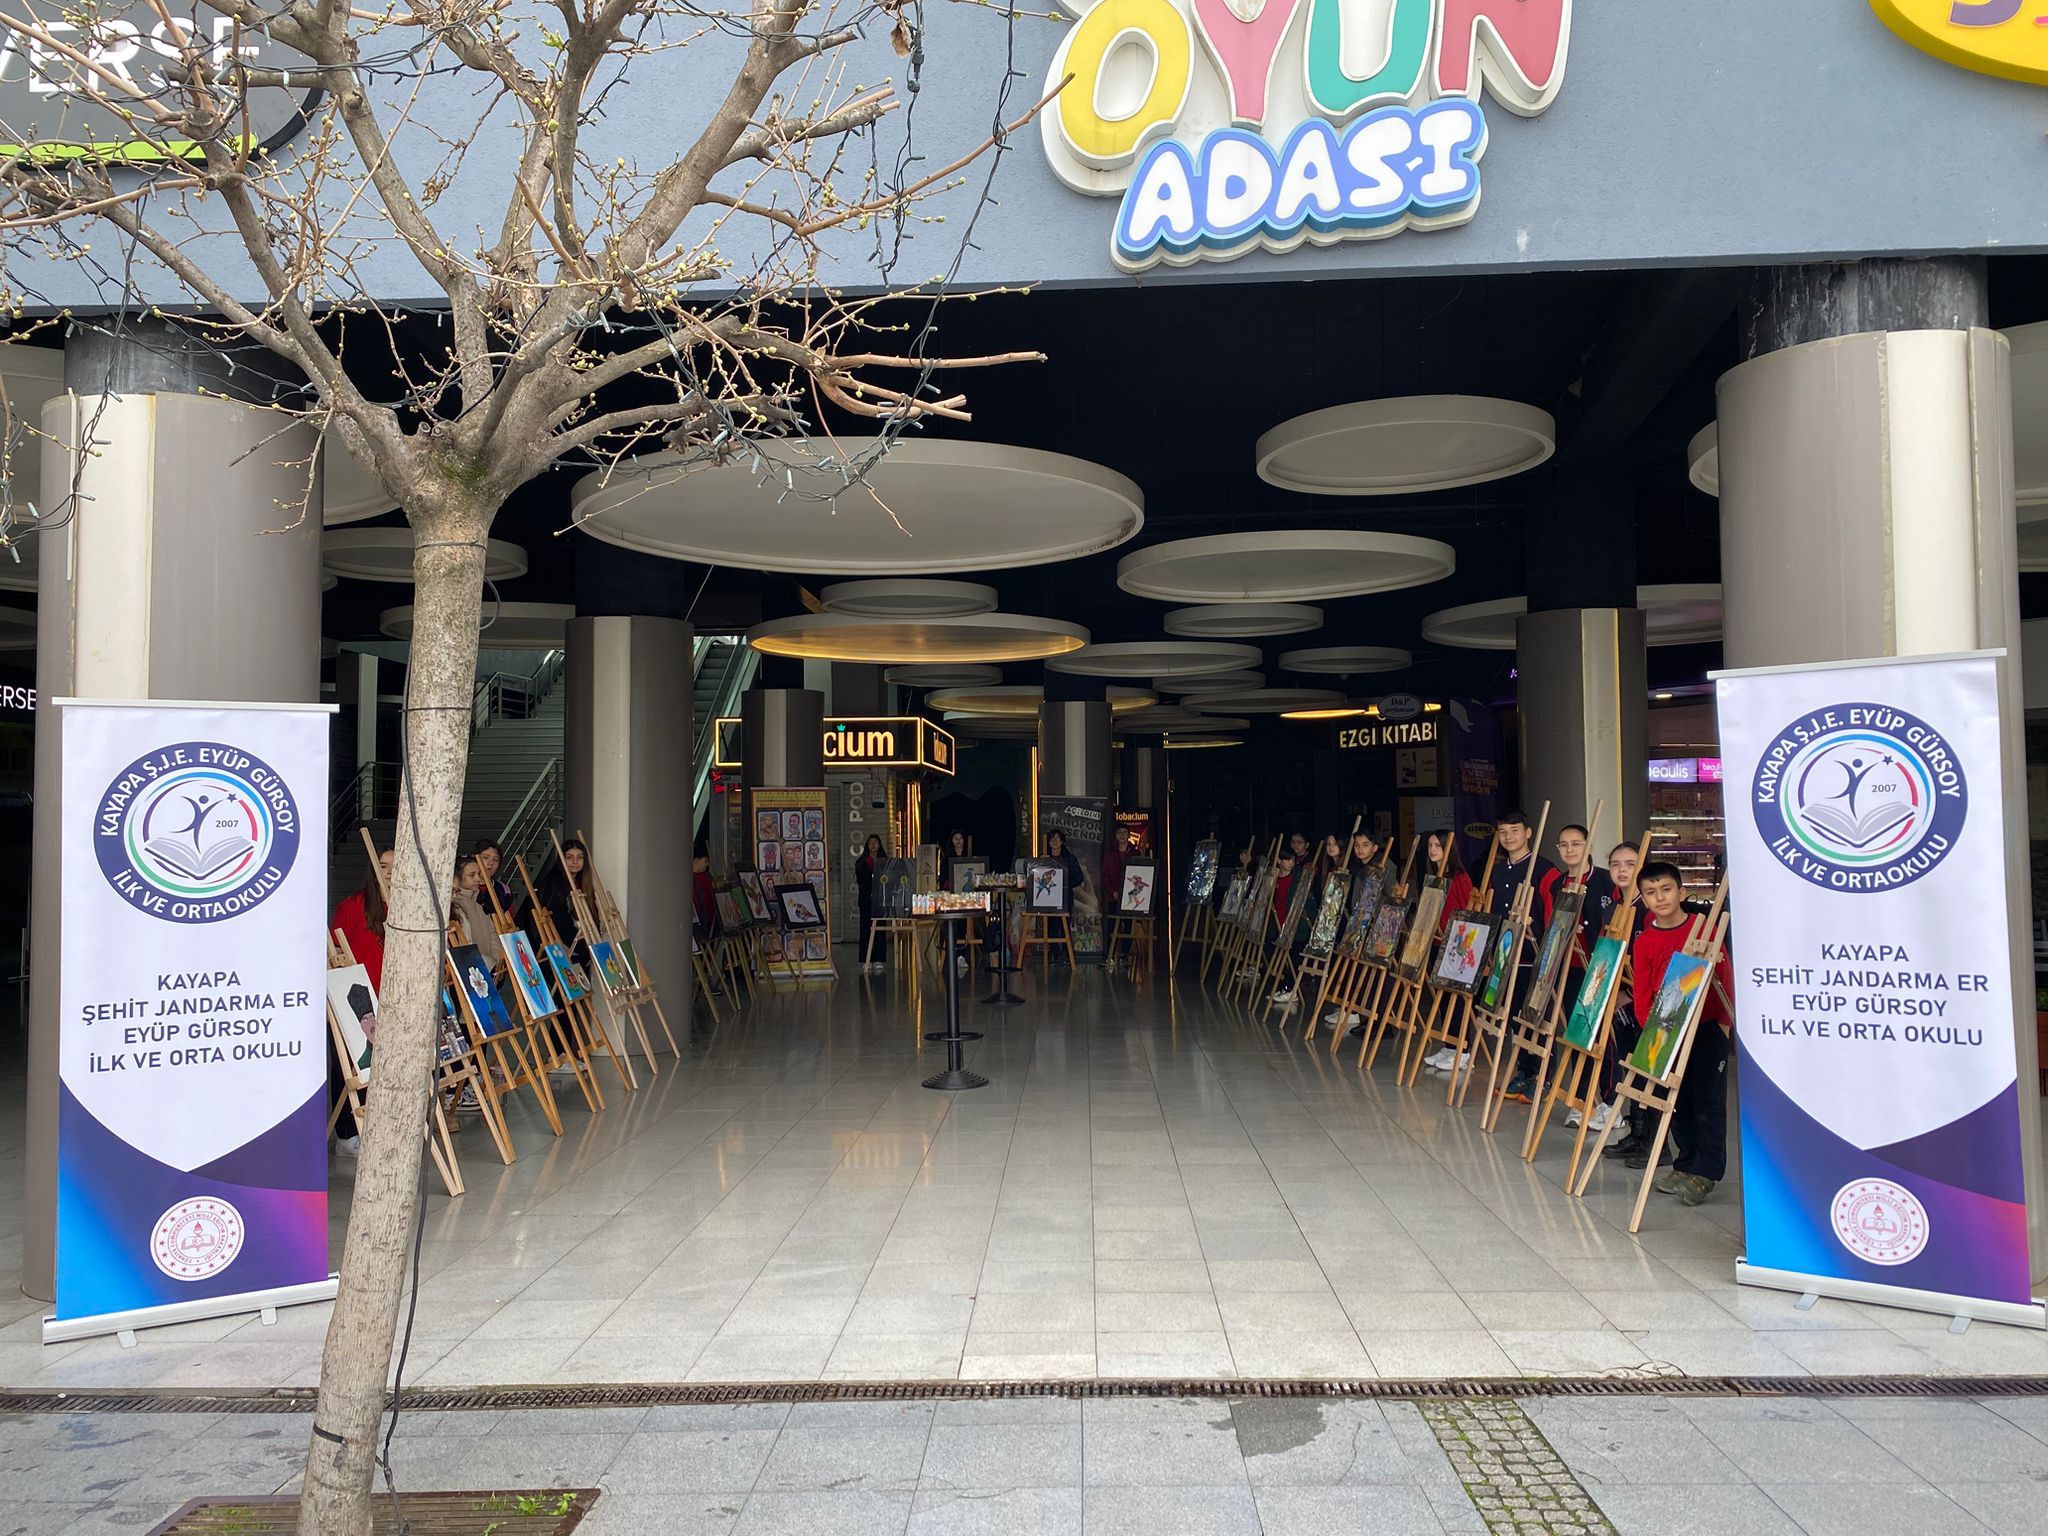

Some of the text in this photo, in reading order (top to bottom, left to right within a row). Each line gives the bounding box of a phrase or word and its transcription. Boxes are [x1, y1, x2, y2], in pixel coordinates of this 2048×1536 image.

[1058, 0, 1561, 158] OYUN
[1127, 108, 1478, 242] ADASI
[1758, 738, 1799, 803] KAYAPA
[1850, 707, 1906, 729] EYÜP
[1905, 725, 1961, 798] GÜRSOY
[100, 772, 146, 837] KAYAPA
[199, 747, 251, 772] EYÜP
[249, 767, 295, 834] GÜRSOY
[1871, 784, 1897, 793] 2007
[215, 819, 239, 828] 2007
[1772, 834, 1949, 888] İLK VE ORTAOKULU
[112, 865, 282, 919] İLK VE ORTAOKULU
[1821, 943, 1910, 963] KAYAPA
[157, 970, 241, 991] KAYAPA
[1752, 964, 1989, 992] ŞEHİT JANDARMA ER
[82, 991, 310, 1025] ŞEHİT JANDARMA ER
[1792, 991, 1947, 1017] EYÜP GÜRSOY
[123, 1017, 273, 1044] EYÜP GÜRSOY
[1761, 1014, 1983, 1046] İLK VE ORTA OKULU
[89, 1040, 302, 1073] İLK VE ORTA OKULU
